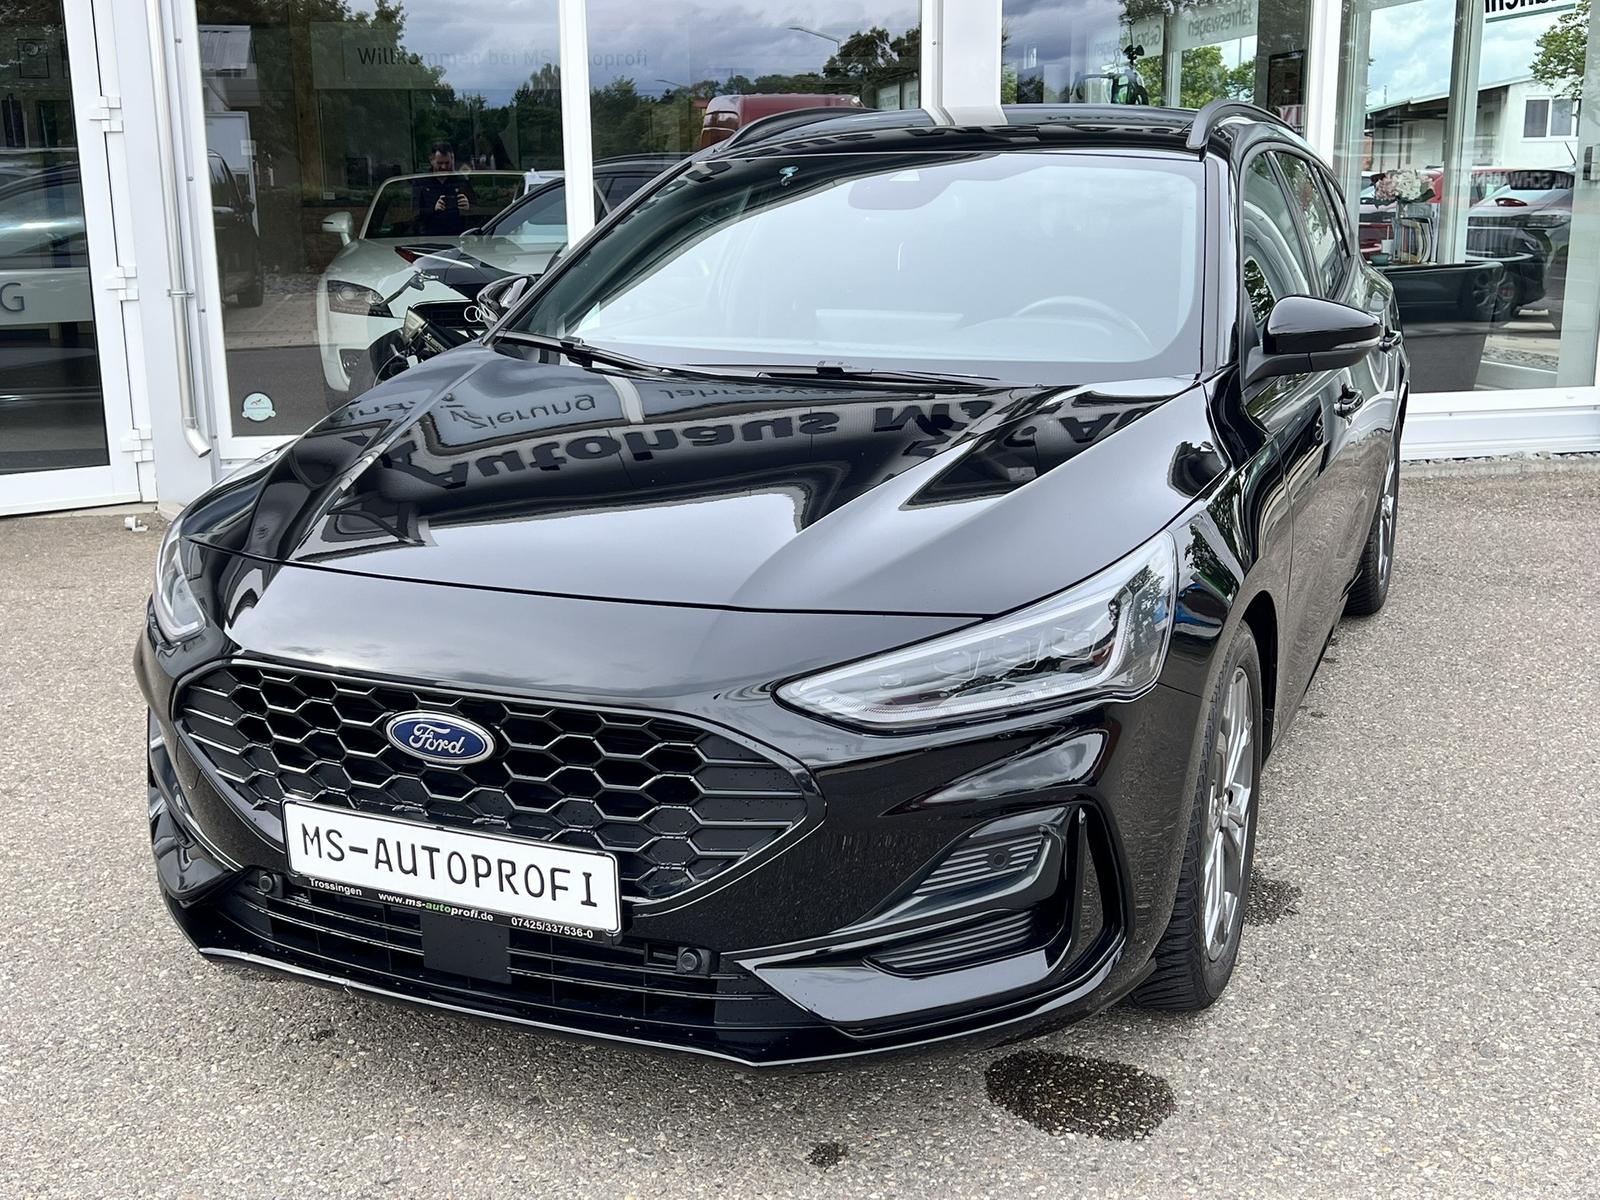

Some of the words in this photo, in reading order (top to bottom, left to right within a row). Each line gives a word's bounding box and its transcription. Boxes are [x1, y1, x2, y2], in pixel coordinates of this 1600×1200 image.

[408, 723, 465, 755] Ford
[301, 822, 598, 908] MS-AUTOPROFI
[308, 877, 363, 897] Trossingen
[378, 892, 494, 922] www.ms-autoprofi.de
[511, 916, 594, 939] 07425/337536-0
